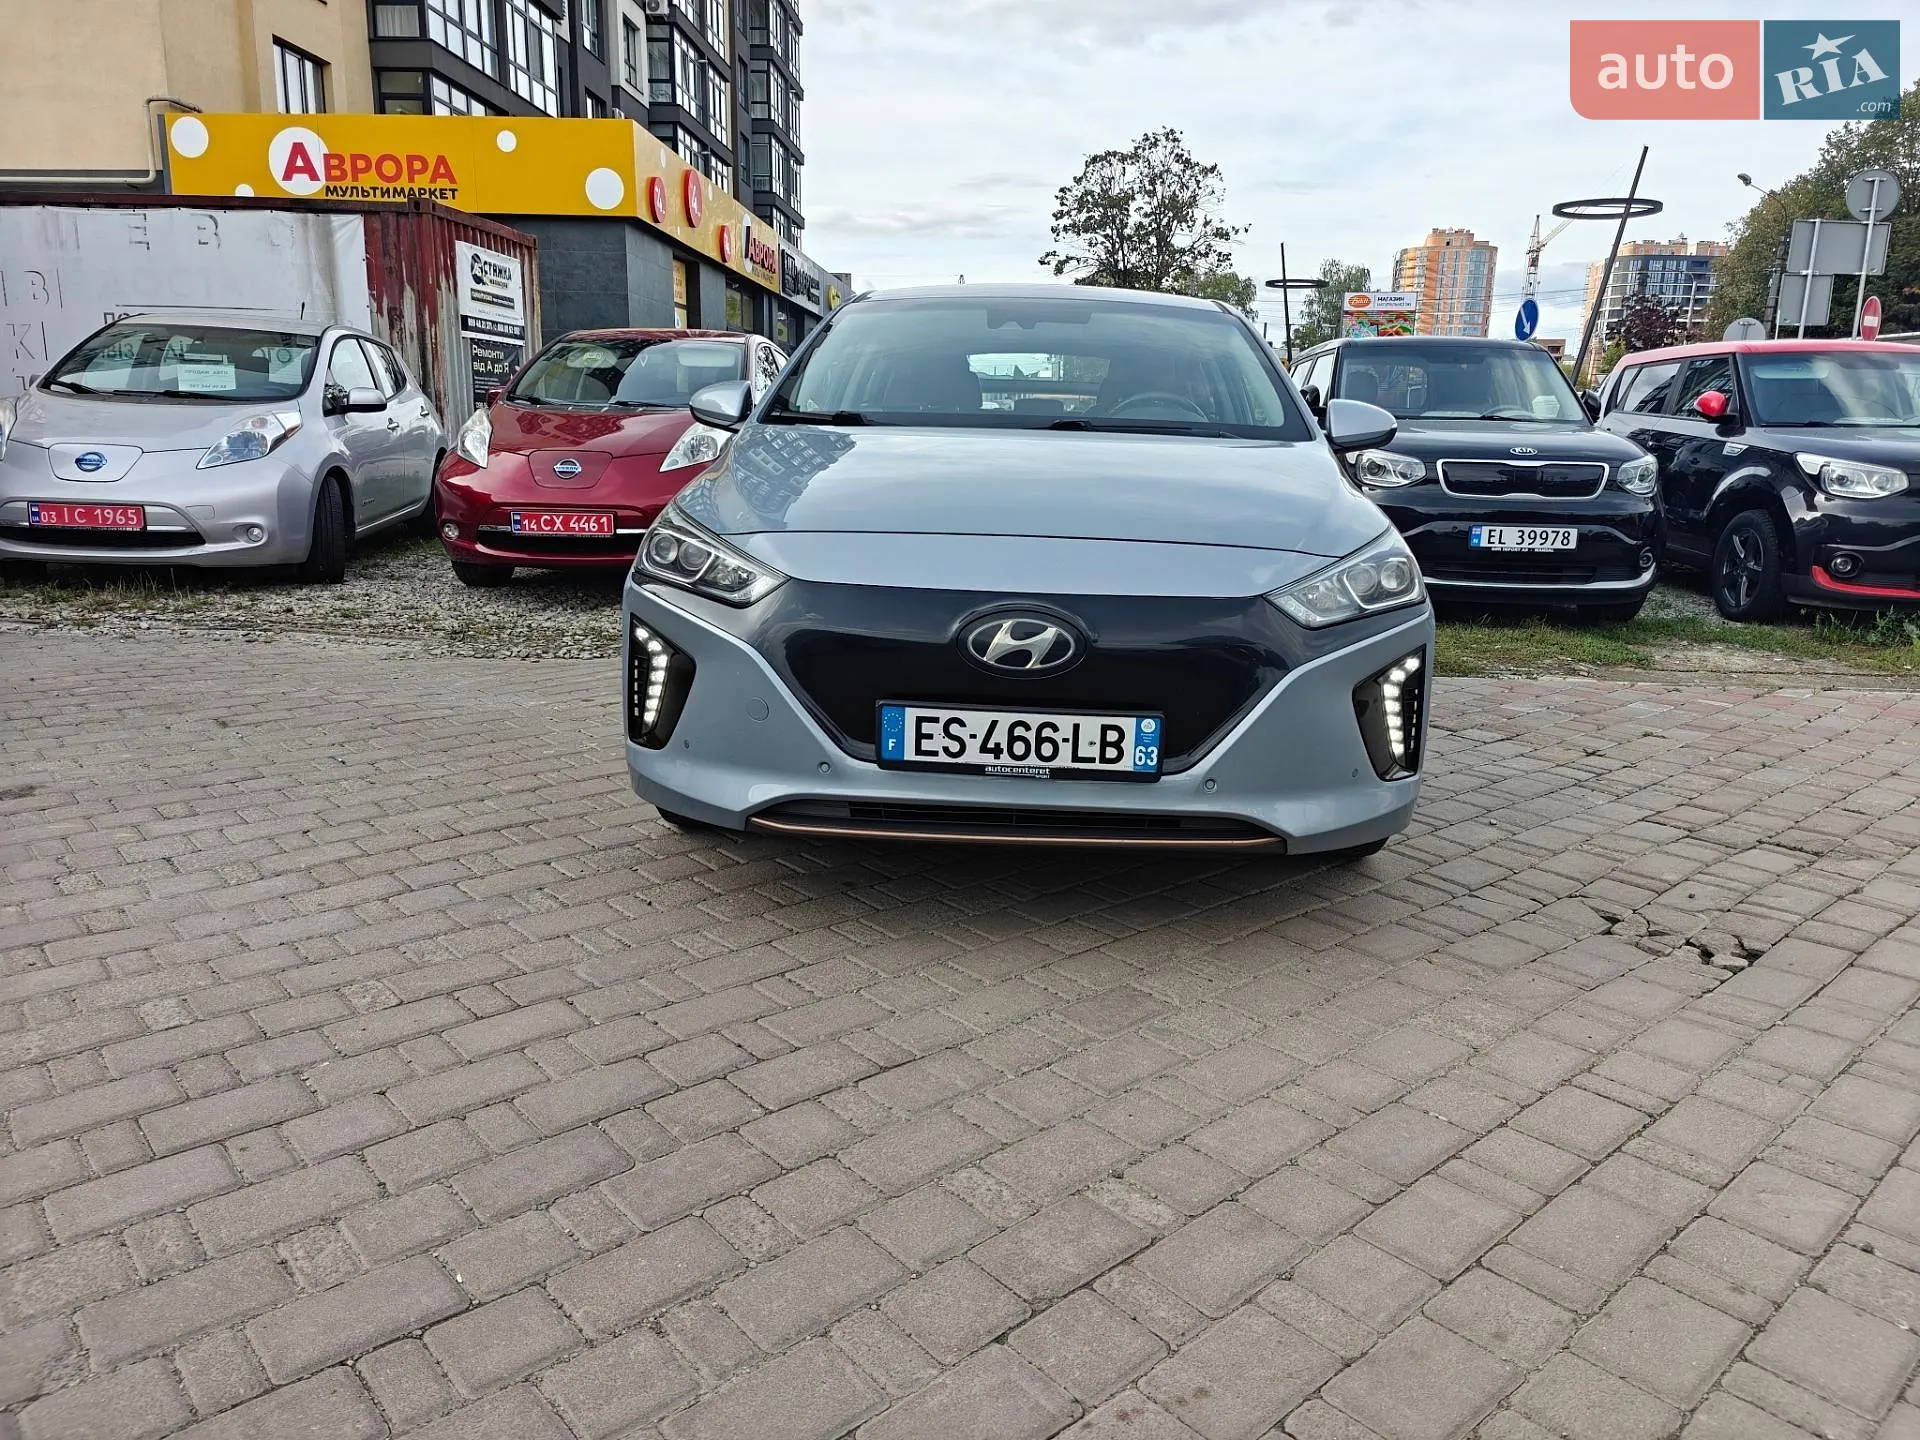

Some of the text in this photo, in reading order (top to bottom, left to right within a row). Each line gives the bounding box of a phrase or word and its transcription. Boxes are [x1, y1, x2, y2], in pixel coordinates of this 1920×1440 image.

[281, 141, 458, 186] АВРОРА
[325, 185, 459, 201] МУЛЬТИМАРКЕТ
[472, 344, 504, 360] Ремонти
[473, 359, 510, 375] від А до Я
[41, 511, 57, 523] 03
[94, 508, 138, 525] 1965
[523, 519, 537, 531] 14
[569, 516, 608, 532] 4461
[1487, 529, 1571, 546] EL 39978
[888, 739, 896, 751] F
[914, 715, 1127, 765] ES-466-LB
[1134, 745, 1159, 766] 63
[984, 765, 1051, 775] autocenteret
